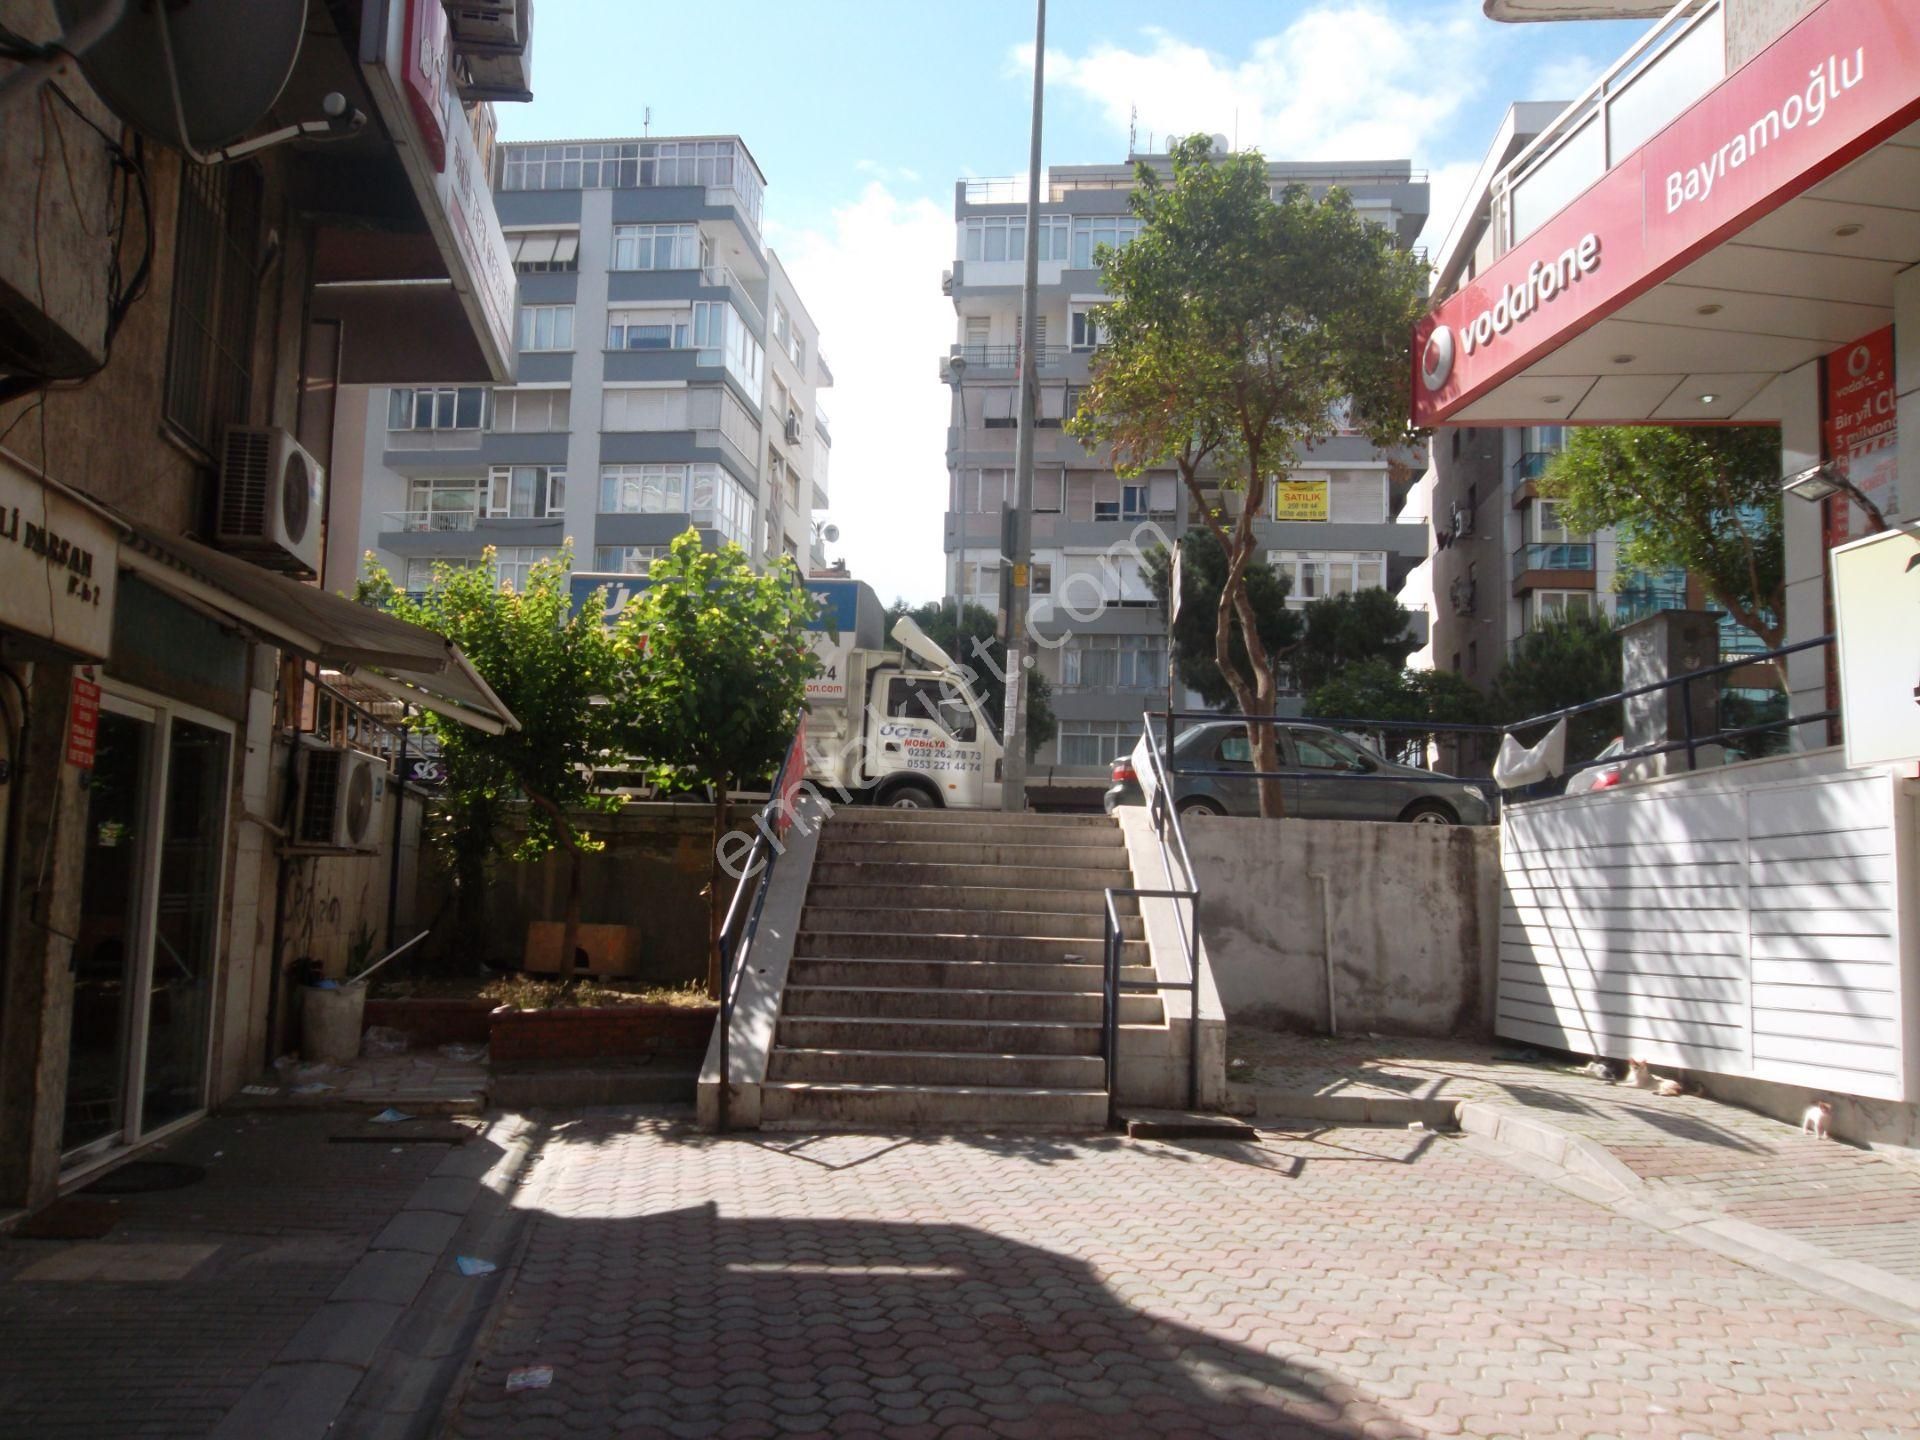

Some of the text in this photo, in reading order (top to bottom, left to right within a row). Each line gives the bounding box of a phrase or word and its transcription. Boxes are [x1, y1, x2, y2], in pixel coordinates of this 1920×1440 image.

[1664, 46, 1865, 216] Bayramoğlu
[1458, 231, 1603, 356] vodafone
[1283, 492, 1321, 502] SATILIK
[908, 748, 932, 758] 0232
[955, 750, 967, 760] 78
[970, 751, 982, 761] 73
[907, 759, 981, 772] 0553 221 44 74
